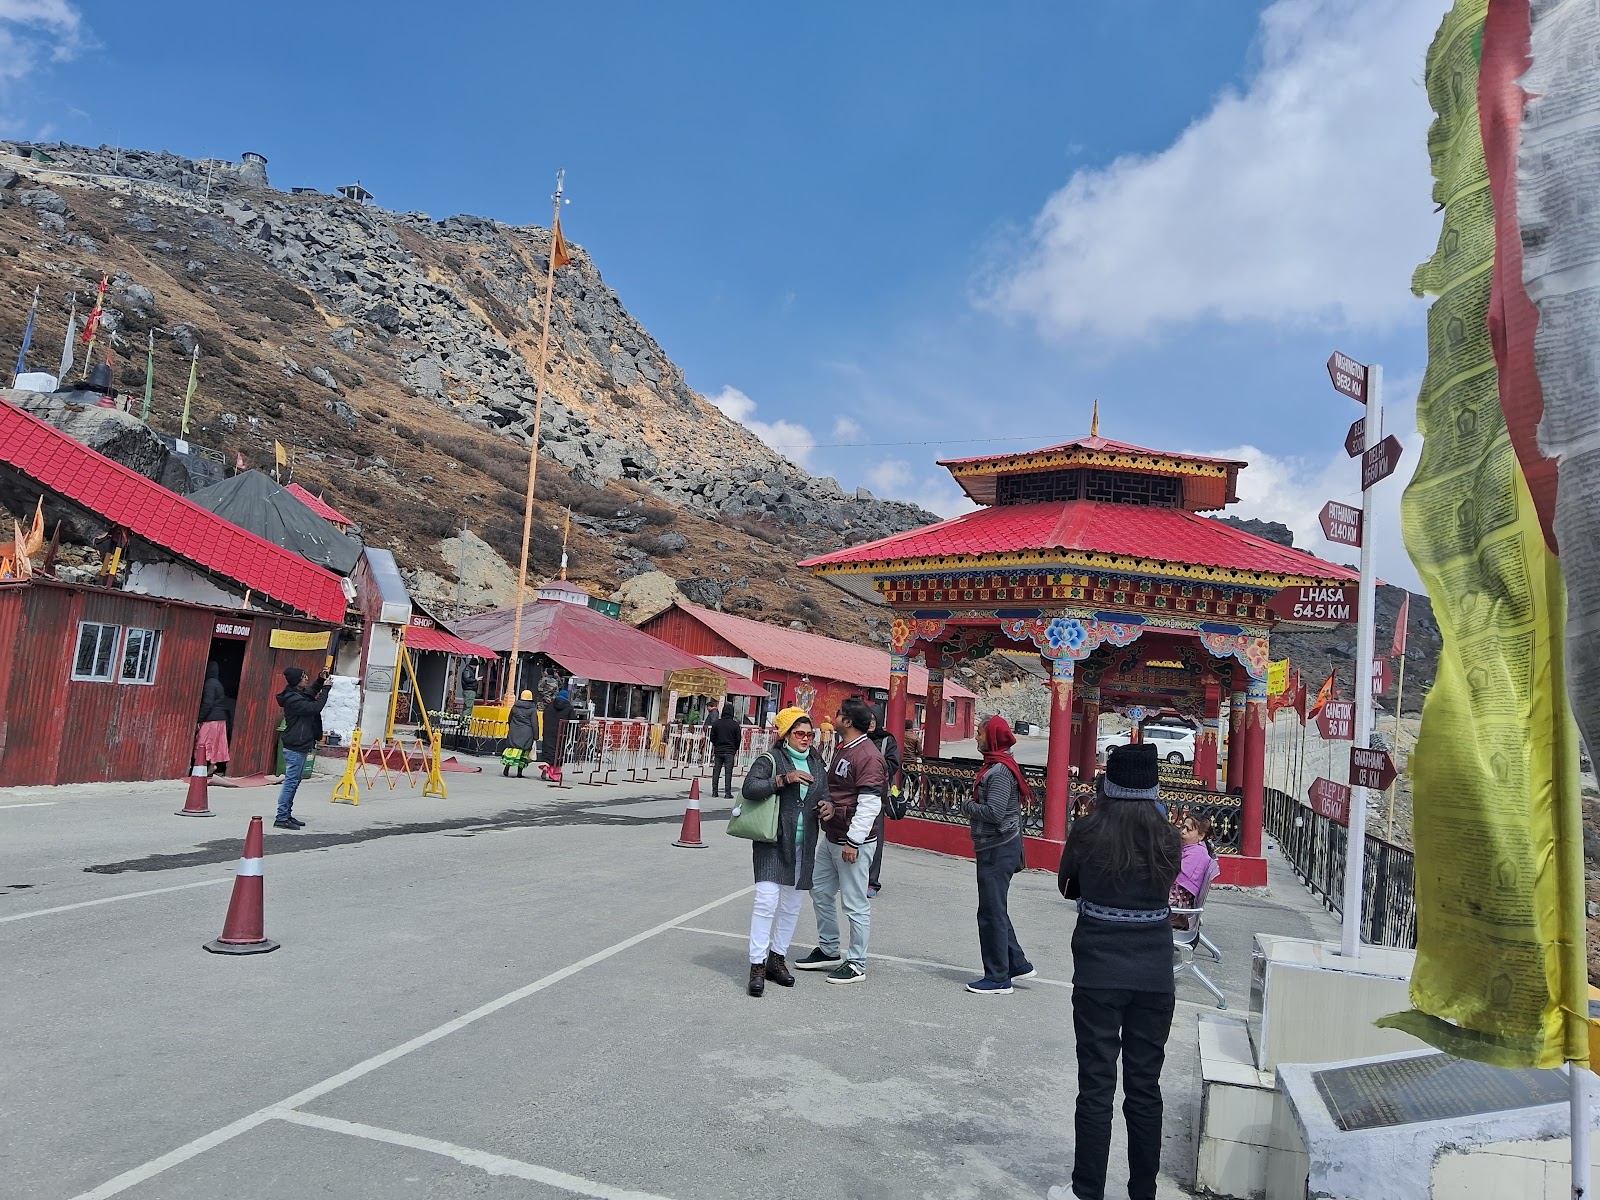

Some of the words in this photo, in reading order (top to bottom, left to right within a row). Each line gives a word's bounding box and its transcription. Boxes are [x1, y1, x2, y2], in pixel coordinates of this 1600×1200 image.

[1335, 352, 1364, 380] WASHINGTON
[1352, 380, 1361, 396] KM
[1368, 442, 1385, 465] DELHI
[1379, 456, 1388, 476] KM
[1299, 588, 1344, 602] LHASA
[1293, 604, 1326, 618] 545
[1327, 604, 1350, 619] KM
[215, 623, 233, 634] SHOE
[233, 625, 250, 636] ROOM
[413, 617, 433, 627] SHOP
[1325, 703, 1352, 720] GANGTOK
[1329, 720, 1337, 735] 56
[1338, 721, 1348, 736] KM
[1354, 750, 1385, 771] GNATHANG
[1369, 770, 1380, 788] KM
[1318, 780, 1336, 799] JELEP
[1337, 786, 1346, 804] LA
